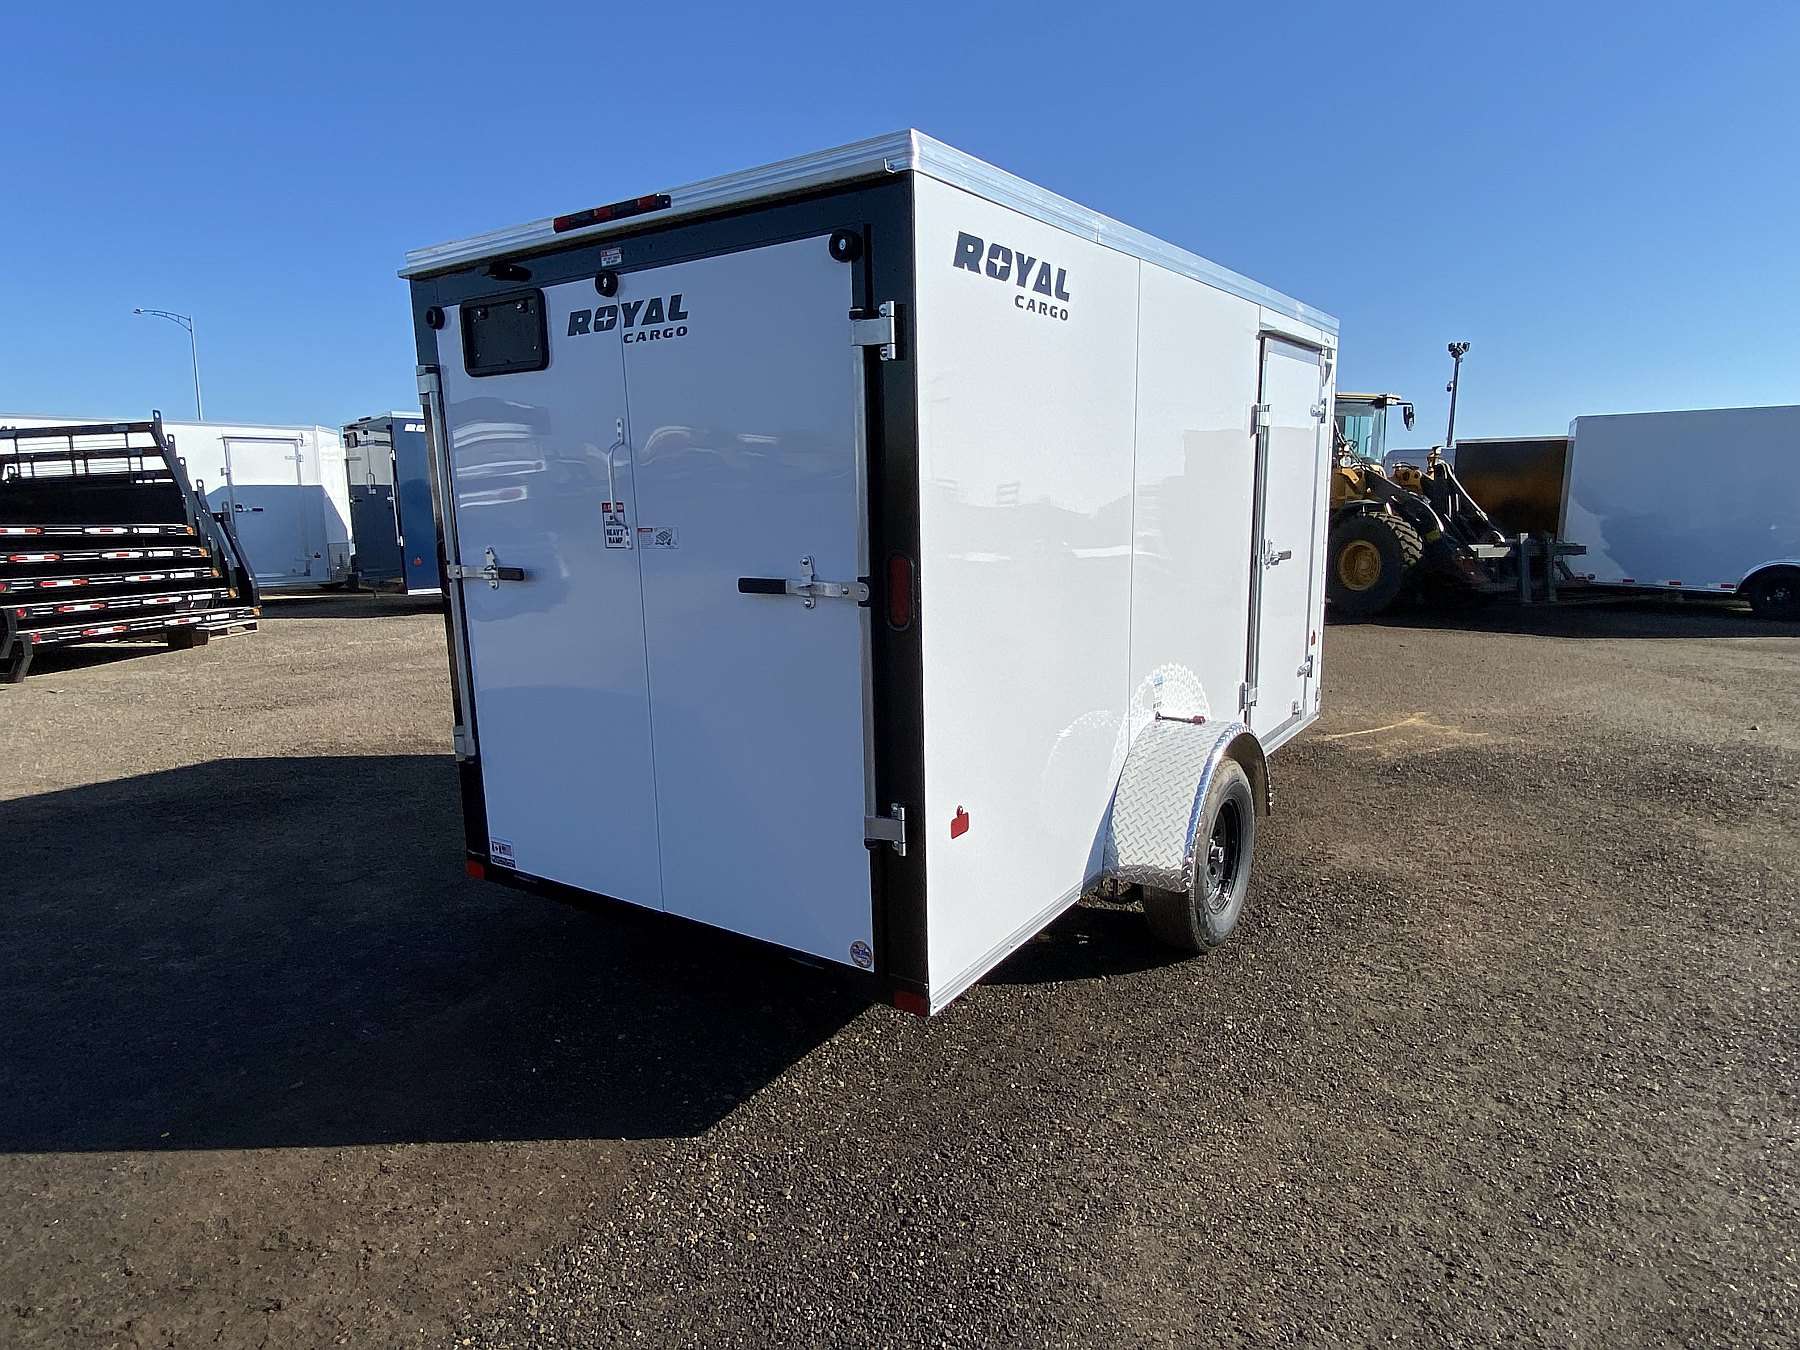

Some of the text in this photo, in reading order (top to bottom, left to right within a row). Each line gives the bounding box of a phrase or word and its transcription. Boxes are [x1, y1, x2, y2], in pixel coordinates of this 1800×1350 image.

[953, 231, 1070, 302] ROYAL
[567, 294, 689, 336] ROYAL
[1014, 294, 1069, 321] CARGO
[623, 326, 688, 344] CARGO
